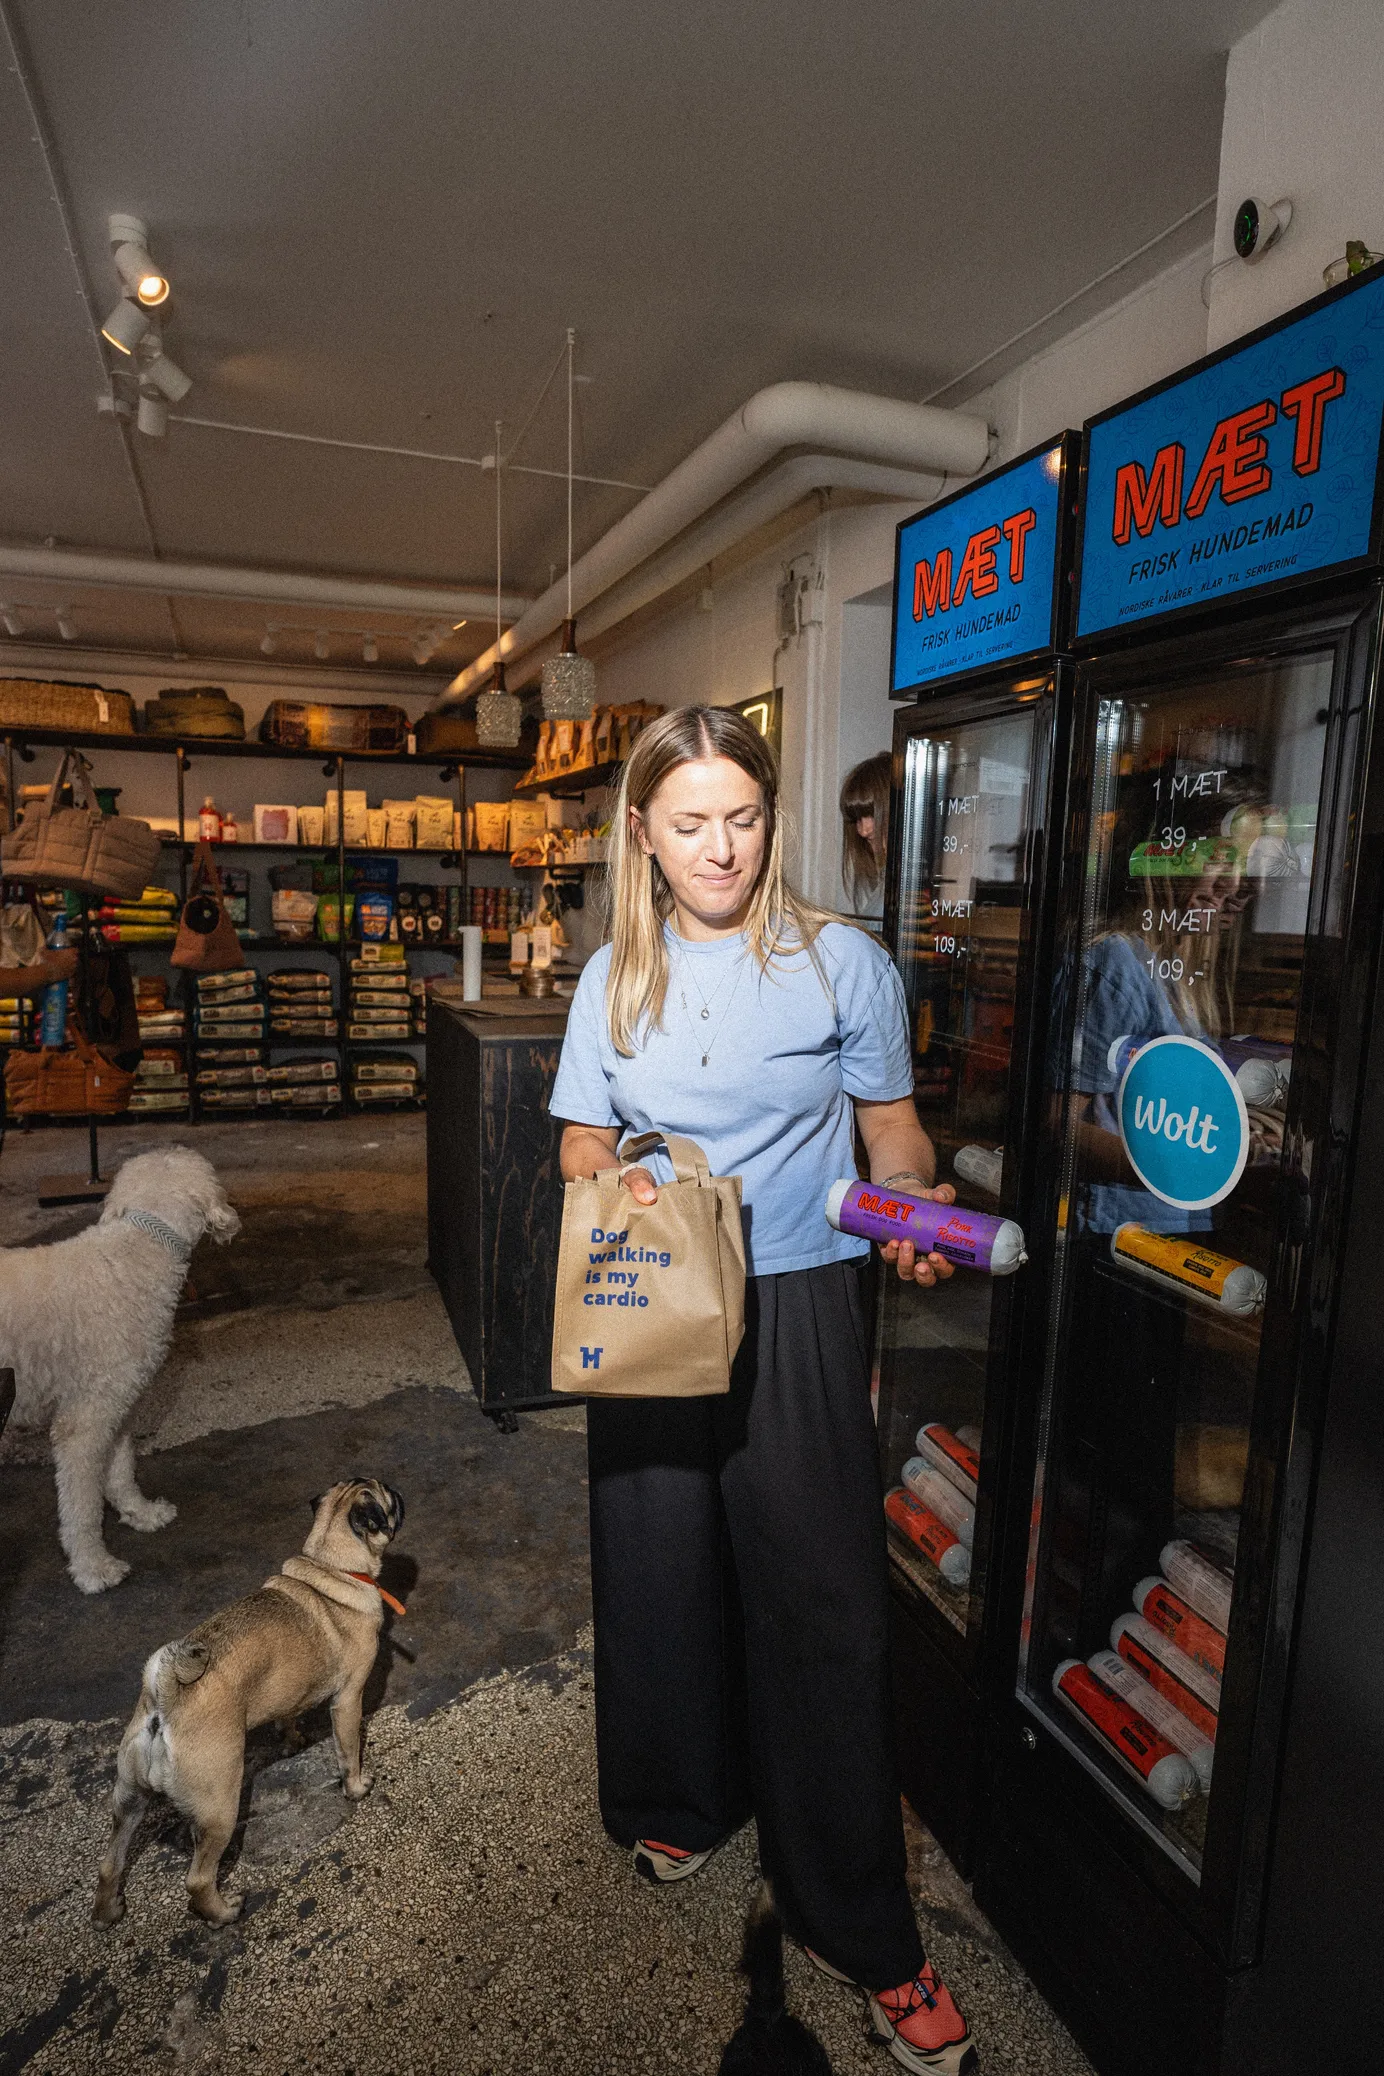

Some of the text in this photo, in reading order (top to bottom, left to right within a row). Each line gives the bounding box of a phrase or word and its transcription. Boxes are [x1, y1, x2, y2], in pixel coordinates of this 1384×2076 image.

[1112, 365, 1347, 547] MÆT
[1128, 502, 1314, 585] FRISK HUNDEMAD
[912, 506, 1037, 623] MÆT
[1118, 554, 1298, 617] NORDISKE RÅVARER KLAR TIL SERVERING
[921, 604, 1021, 653] FRISK HUNDEMAD
[916, 663, 937, 677] NORDISKE
[985, 640, 1014, 656] SERVERING
[1153, 770, 1228, 801] 1 MÆT
[938, 795, 980, 816] 1 MÆT
[931, 899, 973, 918] 3 MÆT
[1141, 908, 1217, 932] 3 MÆT
[1134, 1095, 1220, 1154] Wolt
[857, 1191, 915, 1223] MÆT
[590, 1228, 629, 1245] Dog
[588, 1246, 672, 1268] walking
[585, 1269, 640, 1288] is my
[583, 1291, 649, 1308] cardio
